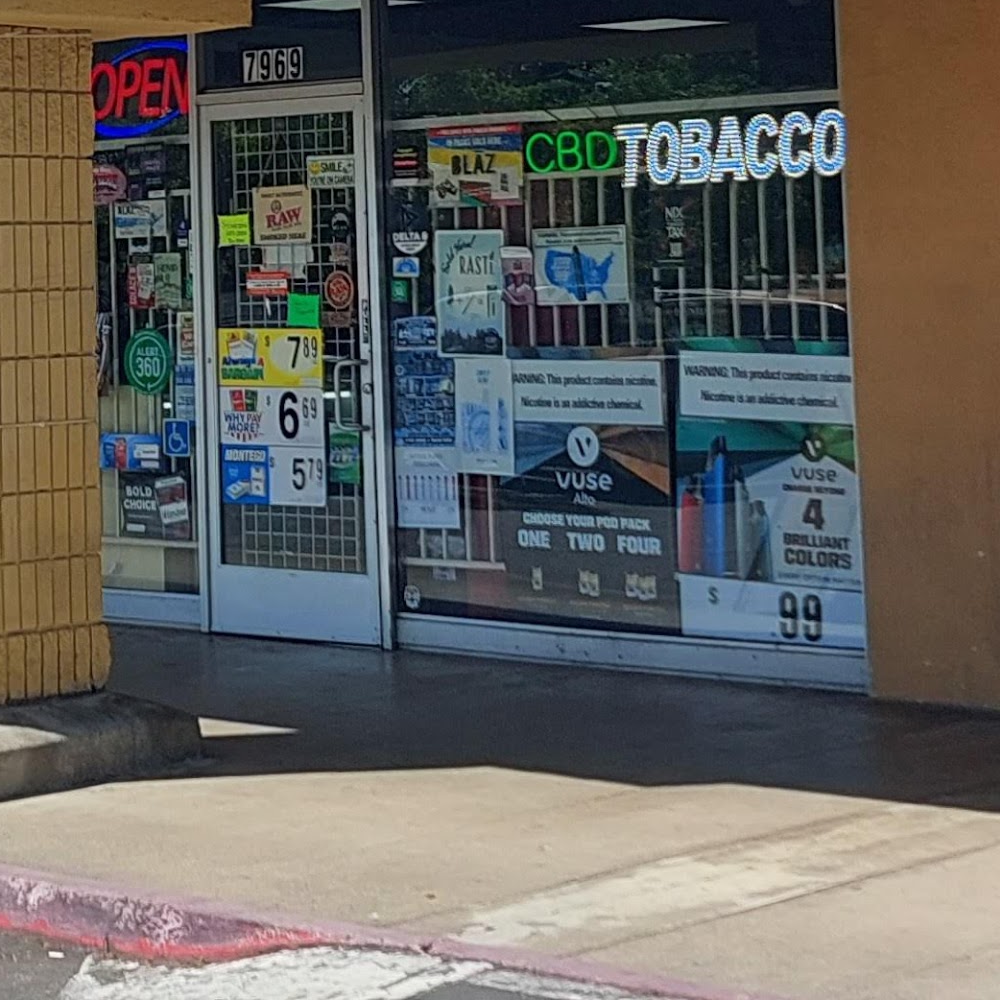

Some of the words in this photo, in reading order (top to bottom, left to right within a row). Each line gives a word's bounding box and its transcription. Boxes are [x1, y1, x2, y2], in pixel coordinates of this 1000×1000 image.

[244, 47, 303, 82] 7969
[92, 57, 190, 120] OPEN
[526, 131, 618, 173] CBD
[613, 108, 846, 188] TOBACCO
[320, 161, 343, 173] SMILE
[265, 206, 302, 229] RAW
[136, 357, 161, 378] 360
[513, 373, 546, 385] ARNING:
[125, 486, 152, 498] BOLD
[123, 499, 158, 511] CHOICE
[803, 498, 825, 531] 4
[523, 512, 565, 527] CHOOSE
[566, 513, 595, 528] YOUR
[596, 516, 619, 529] POD
[620, 517, 652, 531] PACK
[517, 529, 551, 549] ONE
[566, 531, 606, 552] TWO
[616, 534, 662, 556] FOUR
[783, 533, 852, 551] BRILLIANT
[784, 549, 853, 570] COLORS
